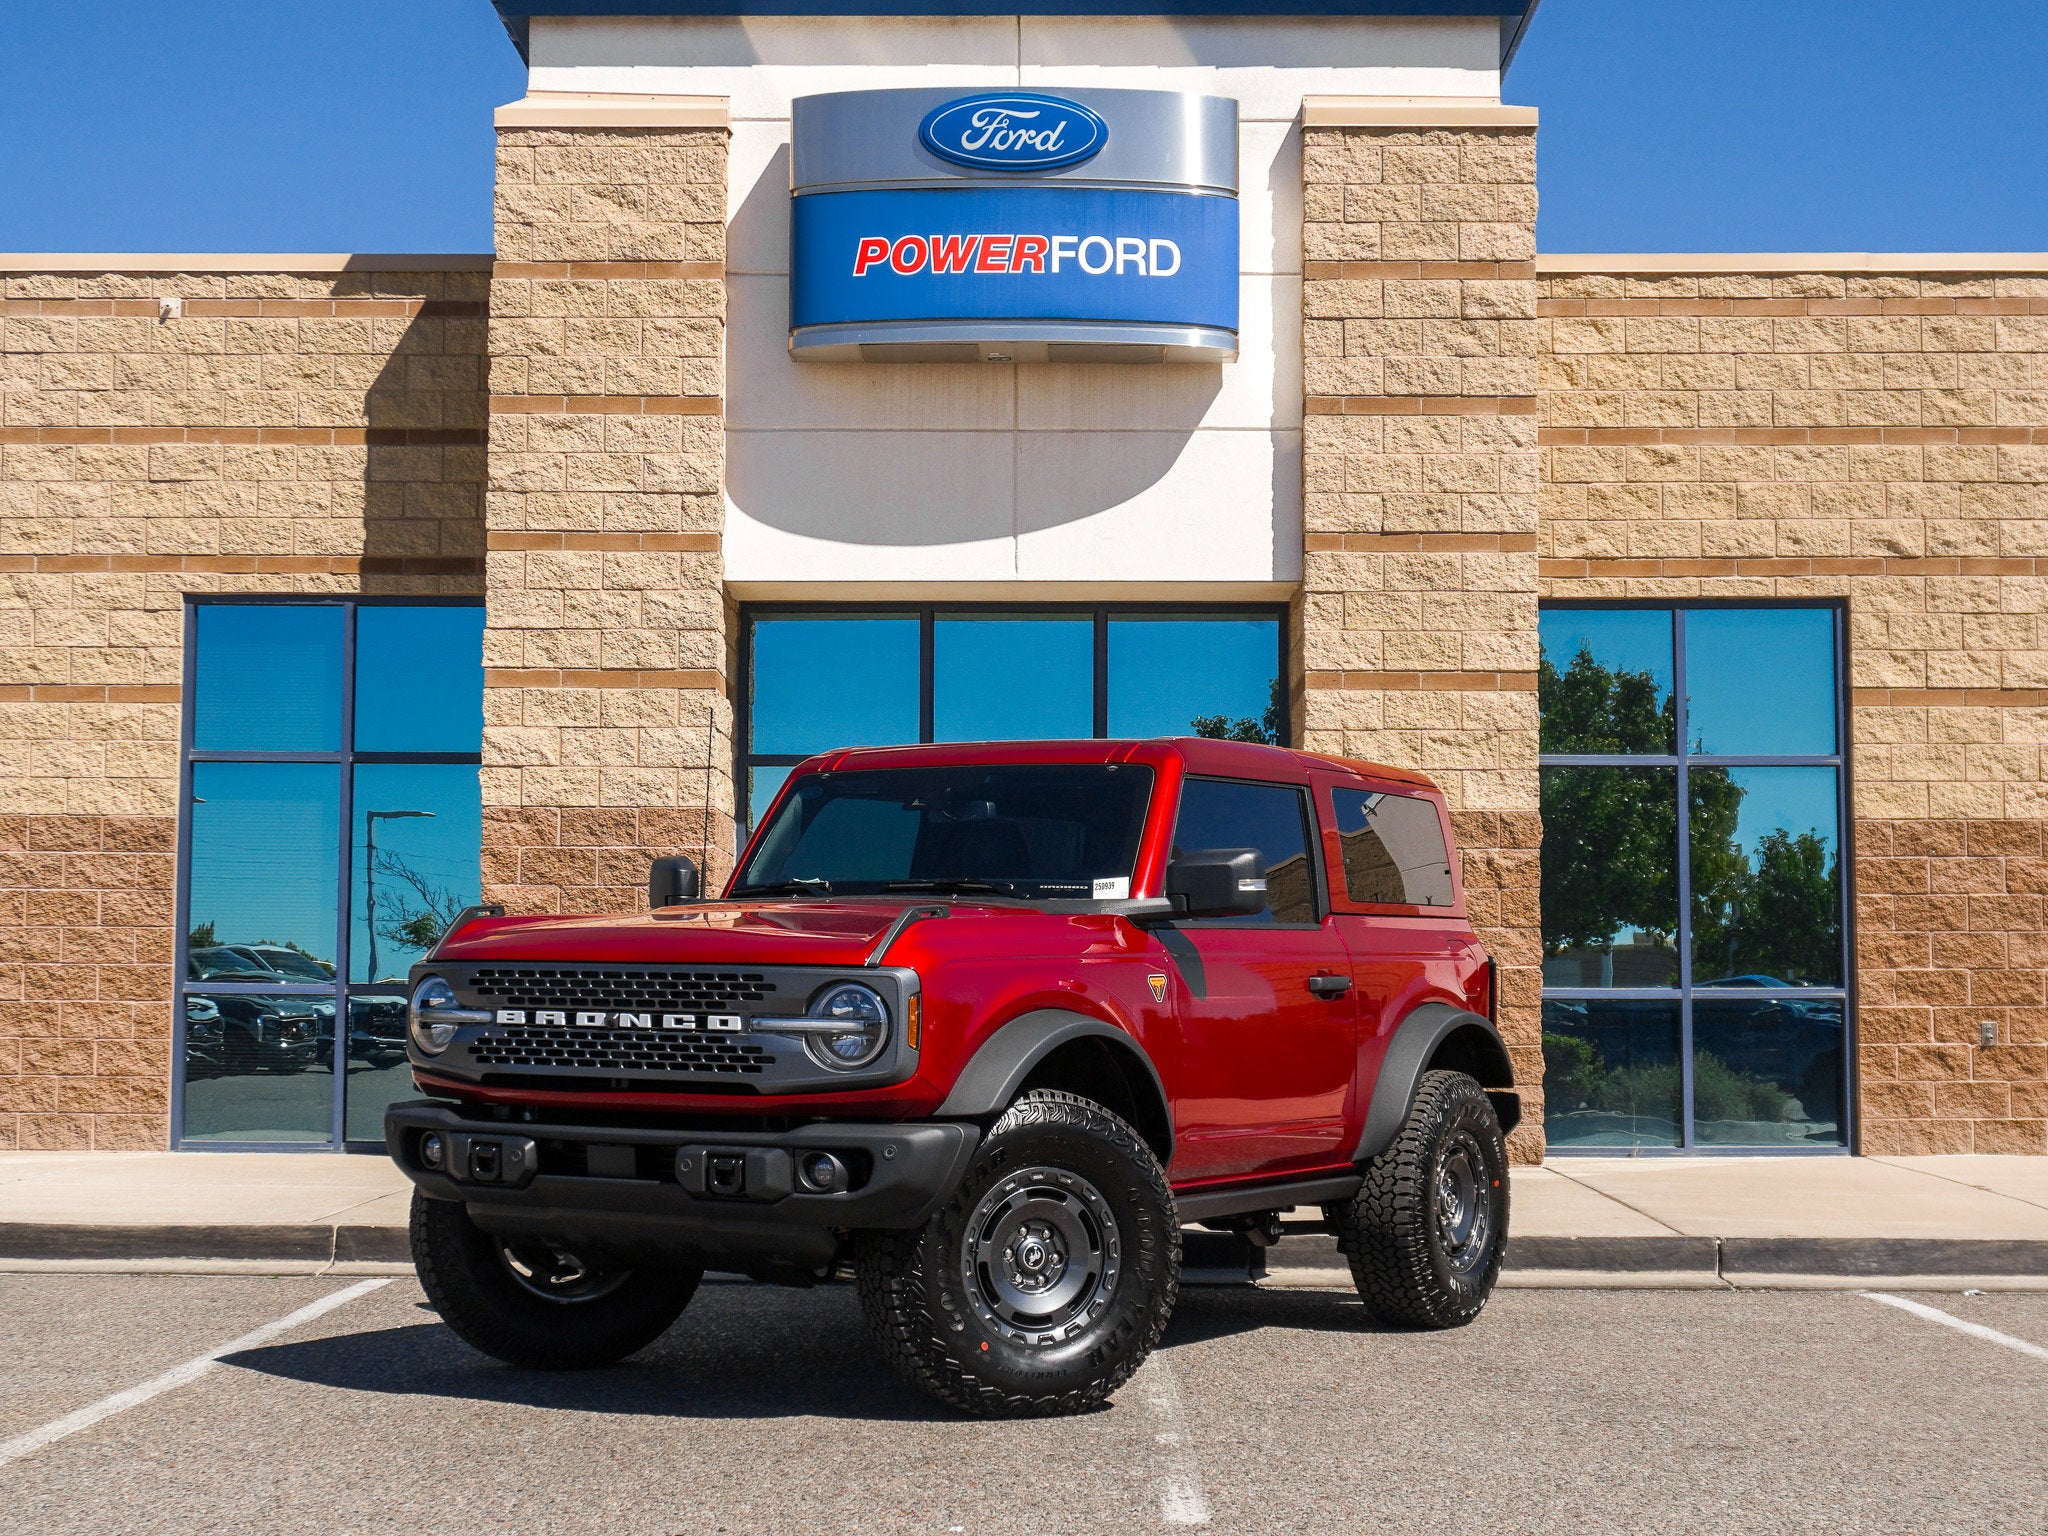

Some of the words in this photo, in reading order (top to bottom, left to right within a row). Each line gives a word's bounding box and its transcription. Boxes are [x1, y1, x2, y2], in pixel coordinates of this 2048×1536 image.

[960, 107, 1067, 152] Ford
[1094, 881, 1115, 891] 250939
[496, 1010, 742, 1031] BRONCO
